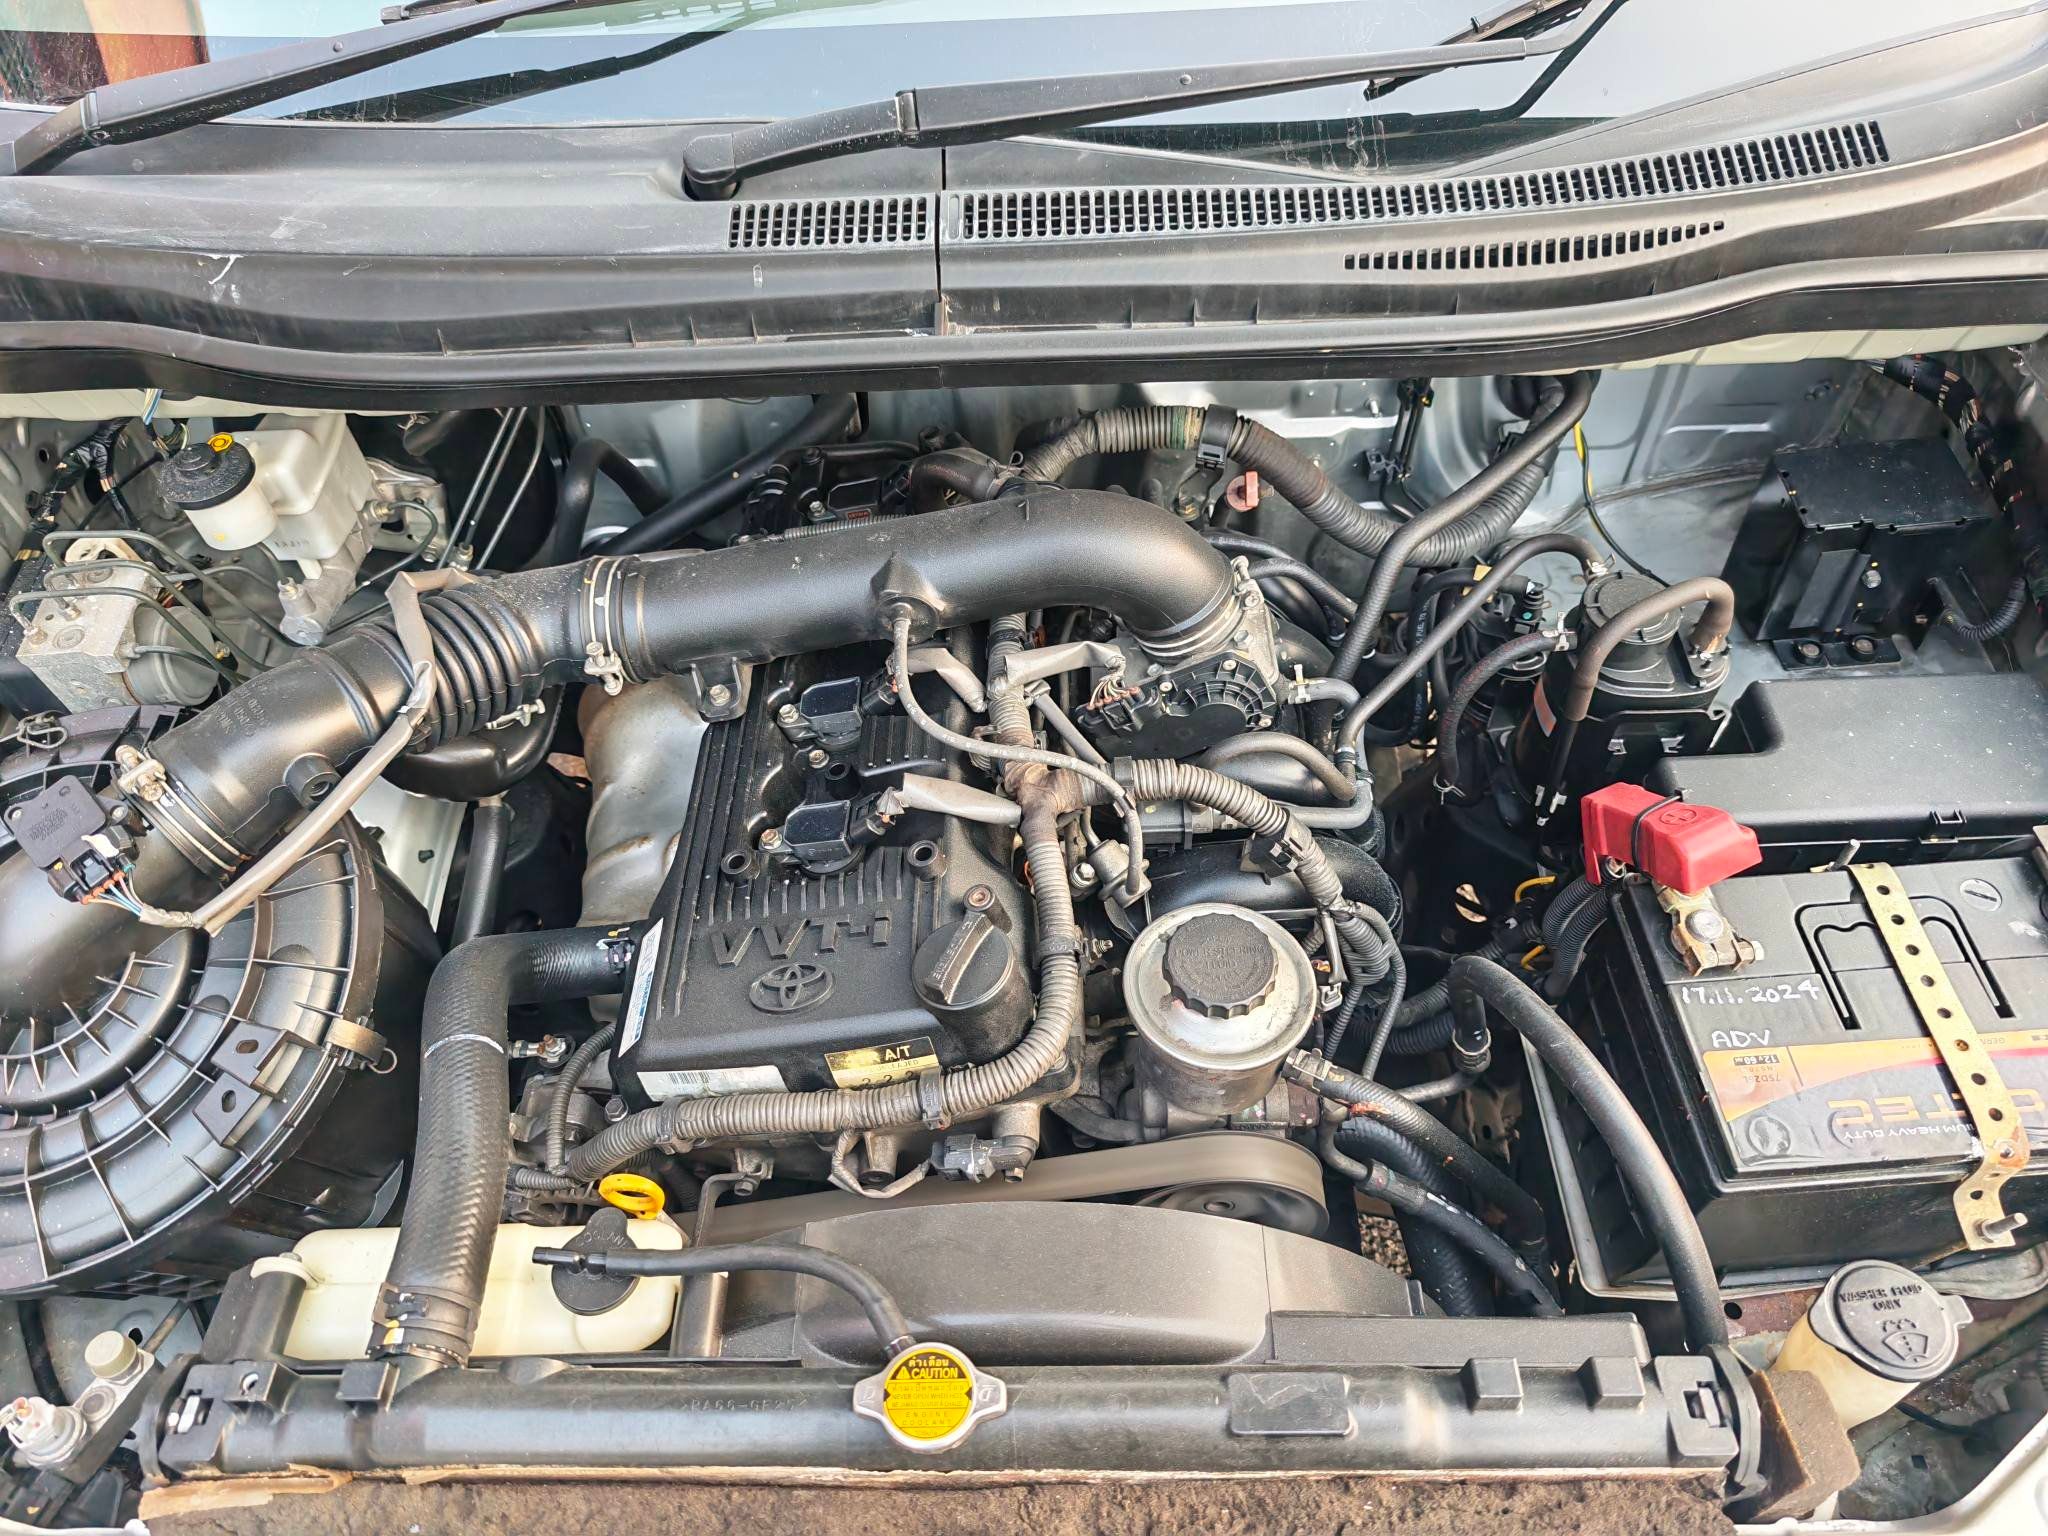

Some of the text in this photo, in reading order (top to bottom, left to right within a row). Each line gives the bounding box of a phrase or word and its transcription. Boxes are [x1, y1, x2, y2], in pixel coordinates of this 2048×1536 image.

[1711, 1029, 1770, 1048] ADV
[885, 1045, 910, 1061] A/T
[1843, 1129, 1885, 1140] DUTY
[1888, 1125, 1940, 1137] HEAVY
[912, 1367, 959, 1379] CAUTION
